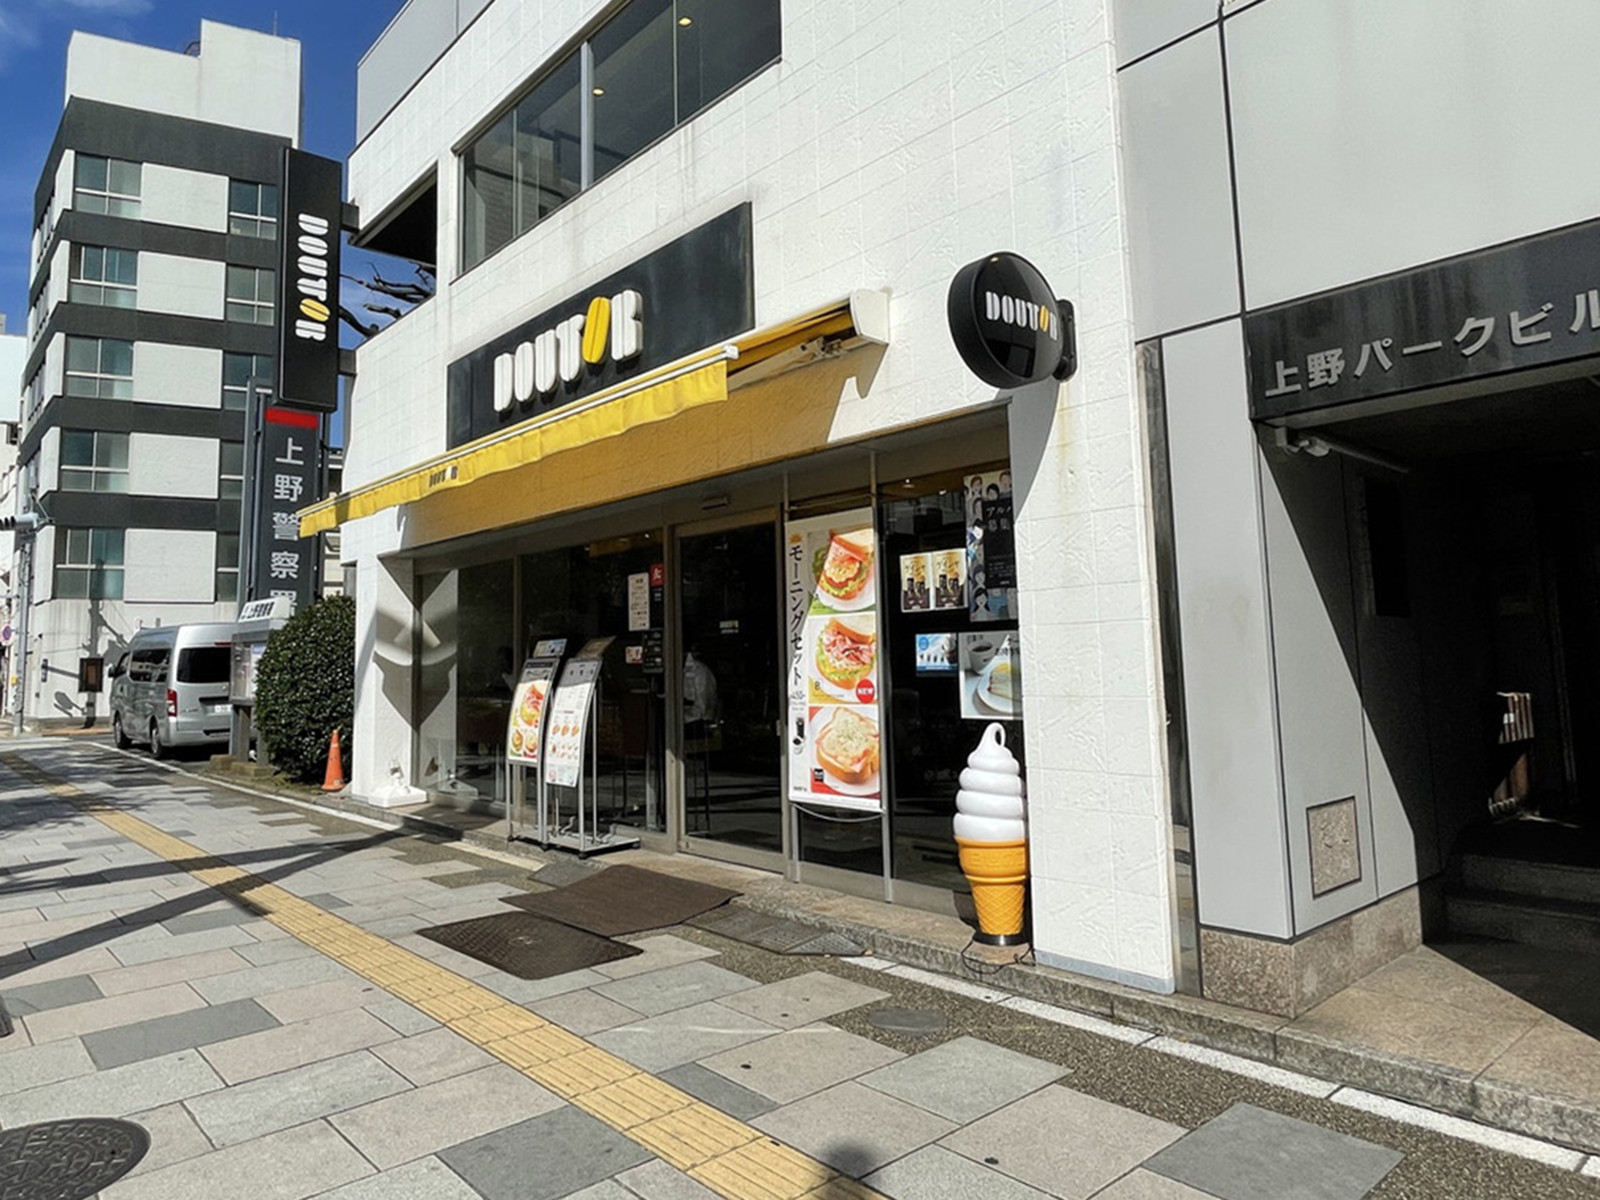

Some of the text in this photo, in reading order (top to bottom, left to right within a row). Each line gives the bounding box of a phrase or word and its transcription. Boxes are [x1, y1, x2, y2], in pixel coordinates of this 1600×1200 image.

[295, 213, 331, 342] DOUTOR
[985, 291, 1058, 341] DOUTOR
[494, 289, 644, 413] DOUTOR
[1265, 288, 1600, 398] 上野パークビル
[789, 545, 804, 686] モーニングセット
